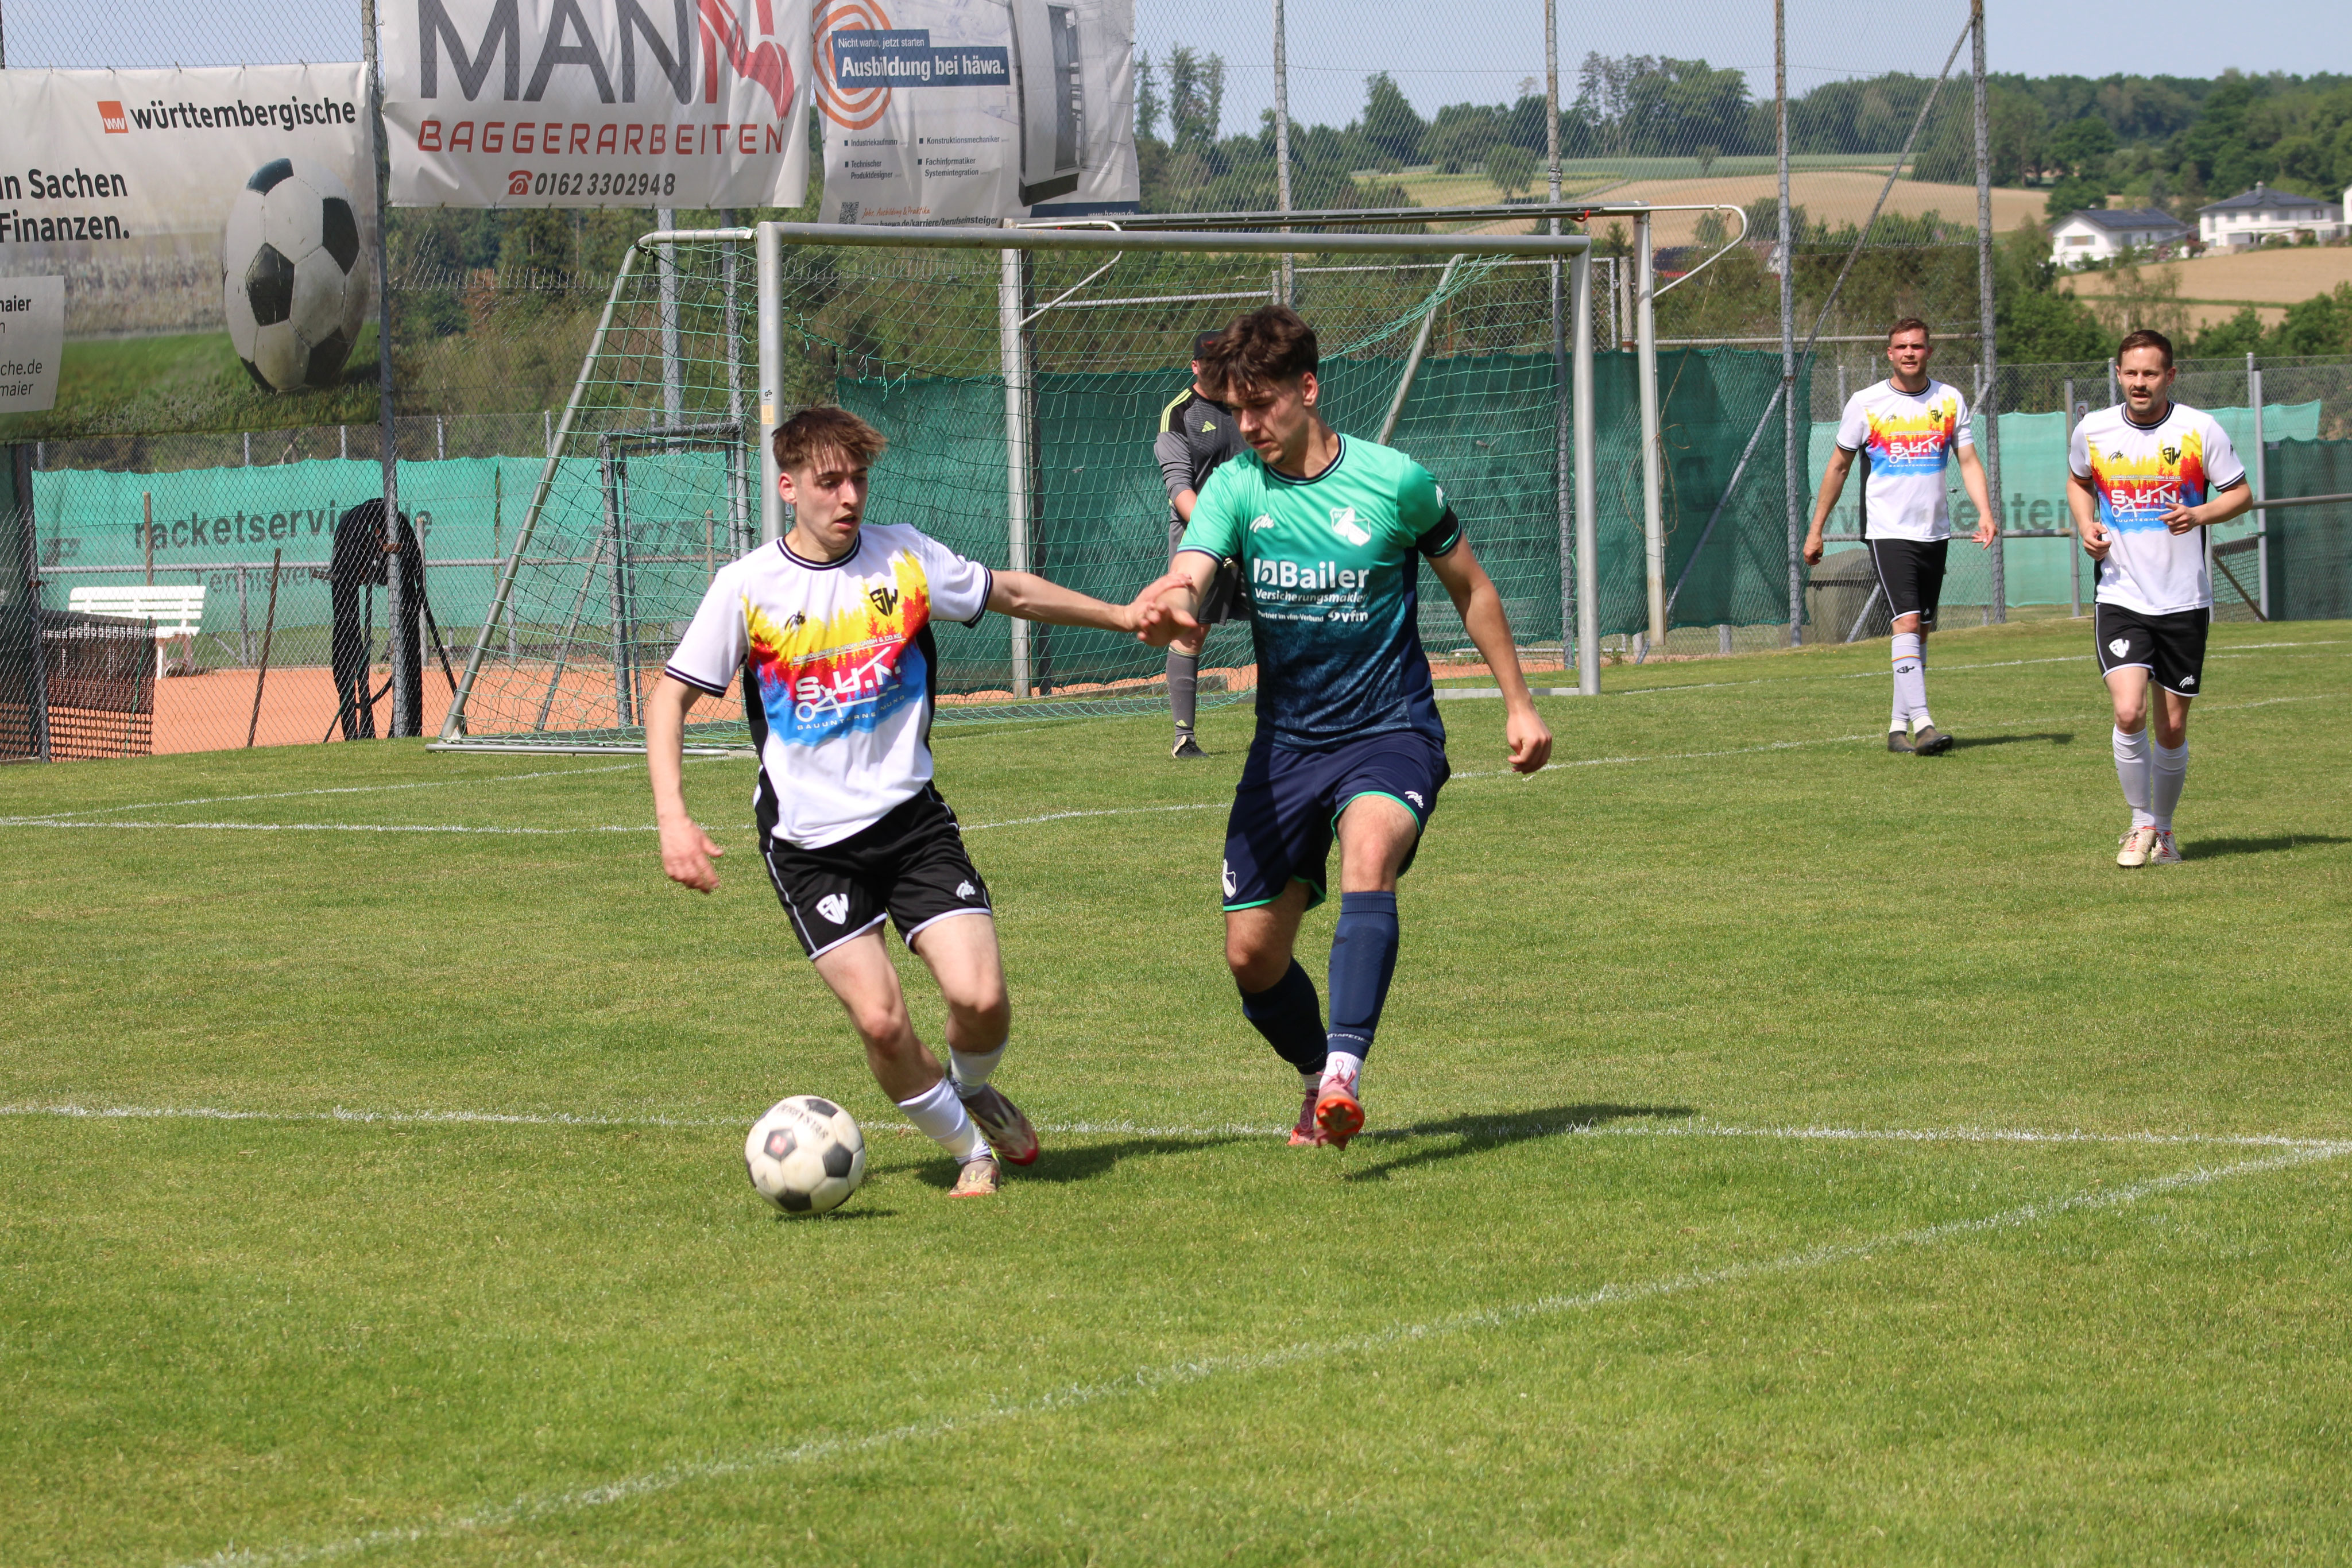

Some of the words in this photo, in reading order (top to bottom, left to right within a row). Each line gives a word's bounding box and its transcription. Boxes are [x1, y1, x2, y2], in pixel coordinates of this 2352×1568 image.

[838, 38, 858, 48] Nicht
[860, 38, 881, 48] warten,
[883, 37, 899, 49] jetzt
[901, 38, 924, 47] starten
[841, 56, 930, 82] Ausbildung
[935, 55, 958, 75] bei
[962, 55, 1005, 75] häwa.
[129, 96, 356, 131] württembergische
[418, 120, 784, 155] BAGGERARBEITEN
[851, 138, 898, 147] Industriekaufmann
[926, 135, 1000, 145] Konstruktionsmechaniker
[851, 160, 881, 168] Technischer
[926, 157, 976, 165] Fachinformatiker
[851, 171, 892, 180] Produktdesigner
[924, 168, 978, 177] Systemintegration
[28, 168, 128, 199] Sachen
[587, 173, 676, 196] 3302948
[0, 209, 130, 243] Finanzen.
[1280, 560, 1369, 590] Bailer
[1255, 588, 1368, 605] Versicherungsmakler
[1258, 610, 1278, 620] Partner
[1341, 609, 1368, 623] vfm
[797, 695, 905, 730] BAUUNTERNEMUNG
